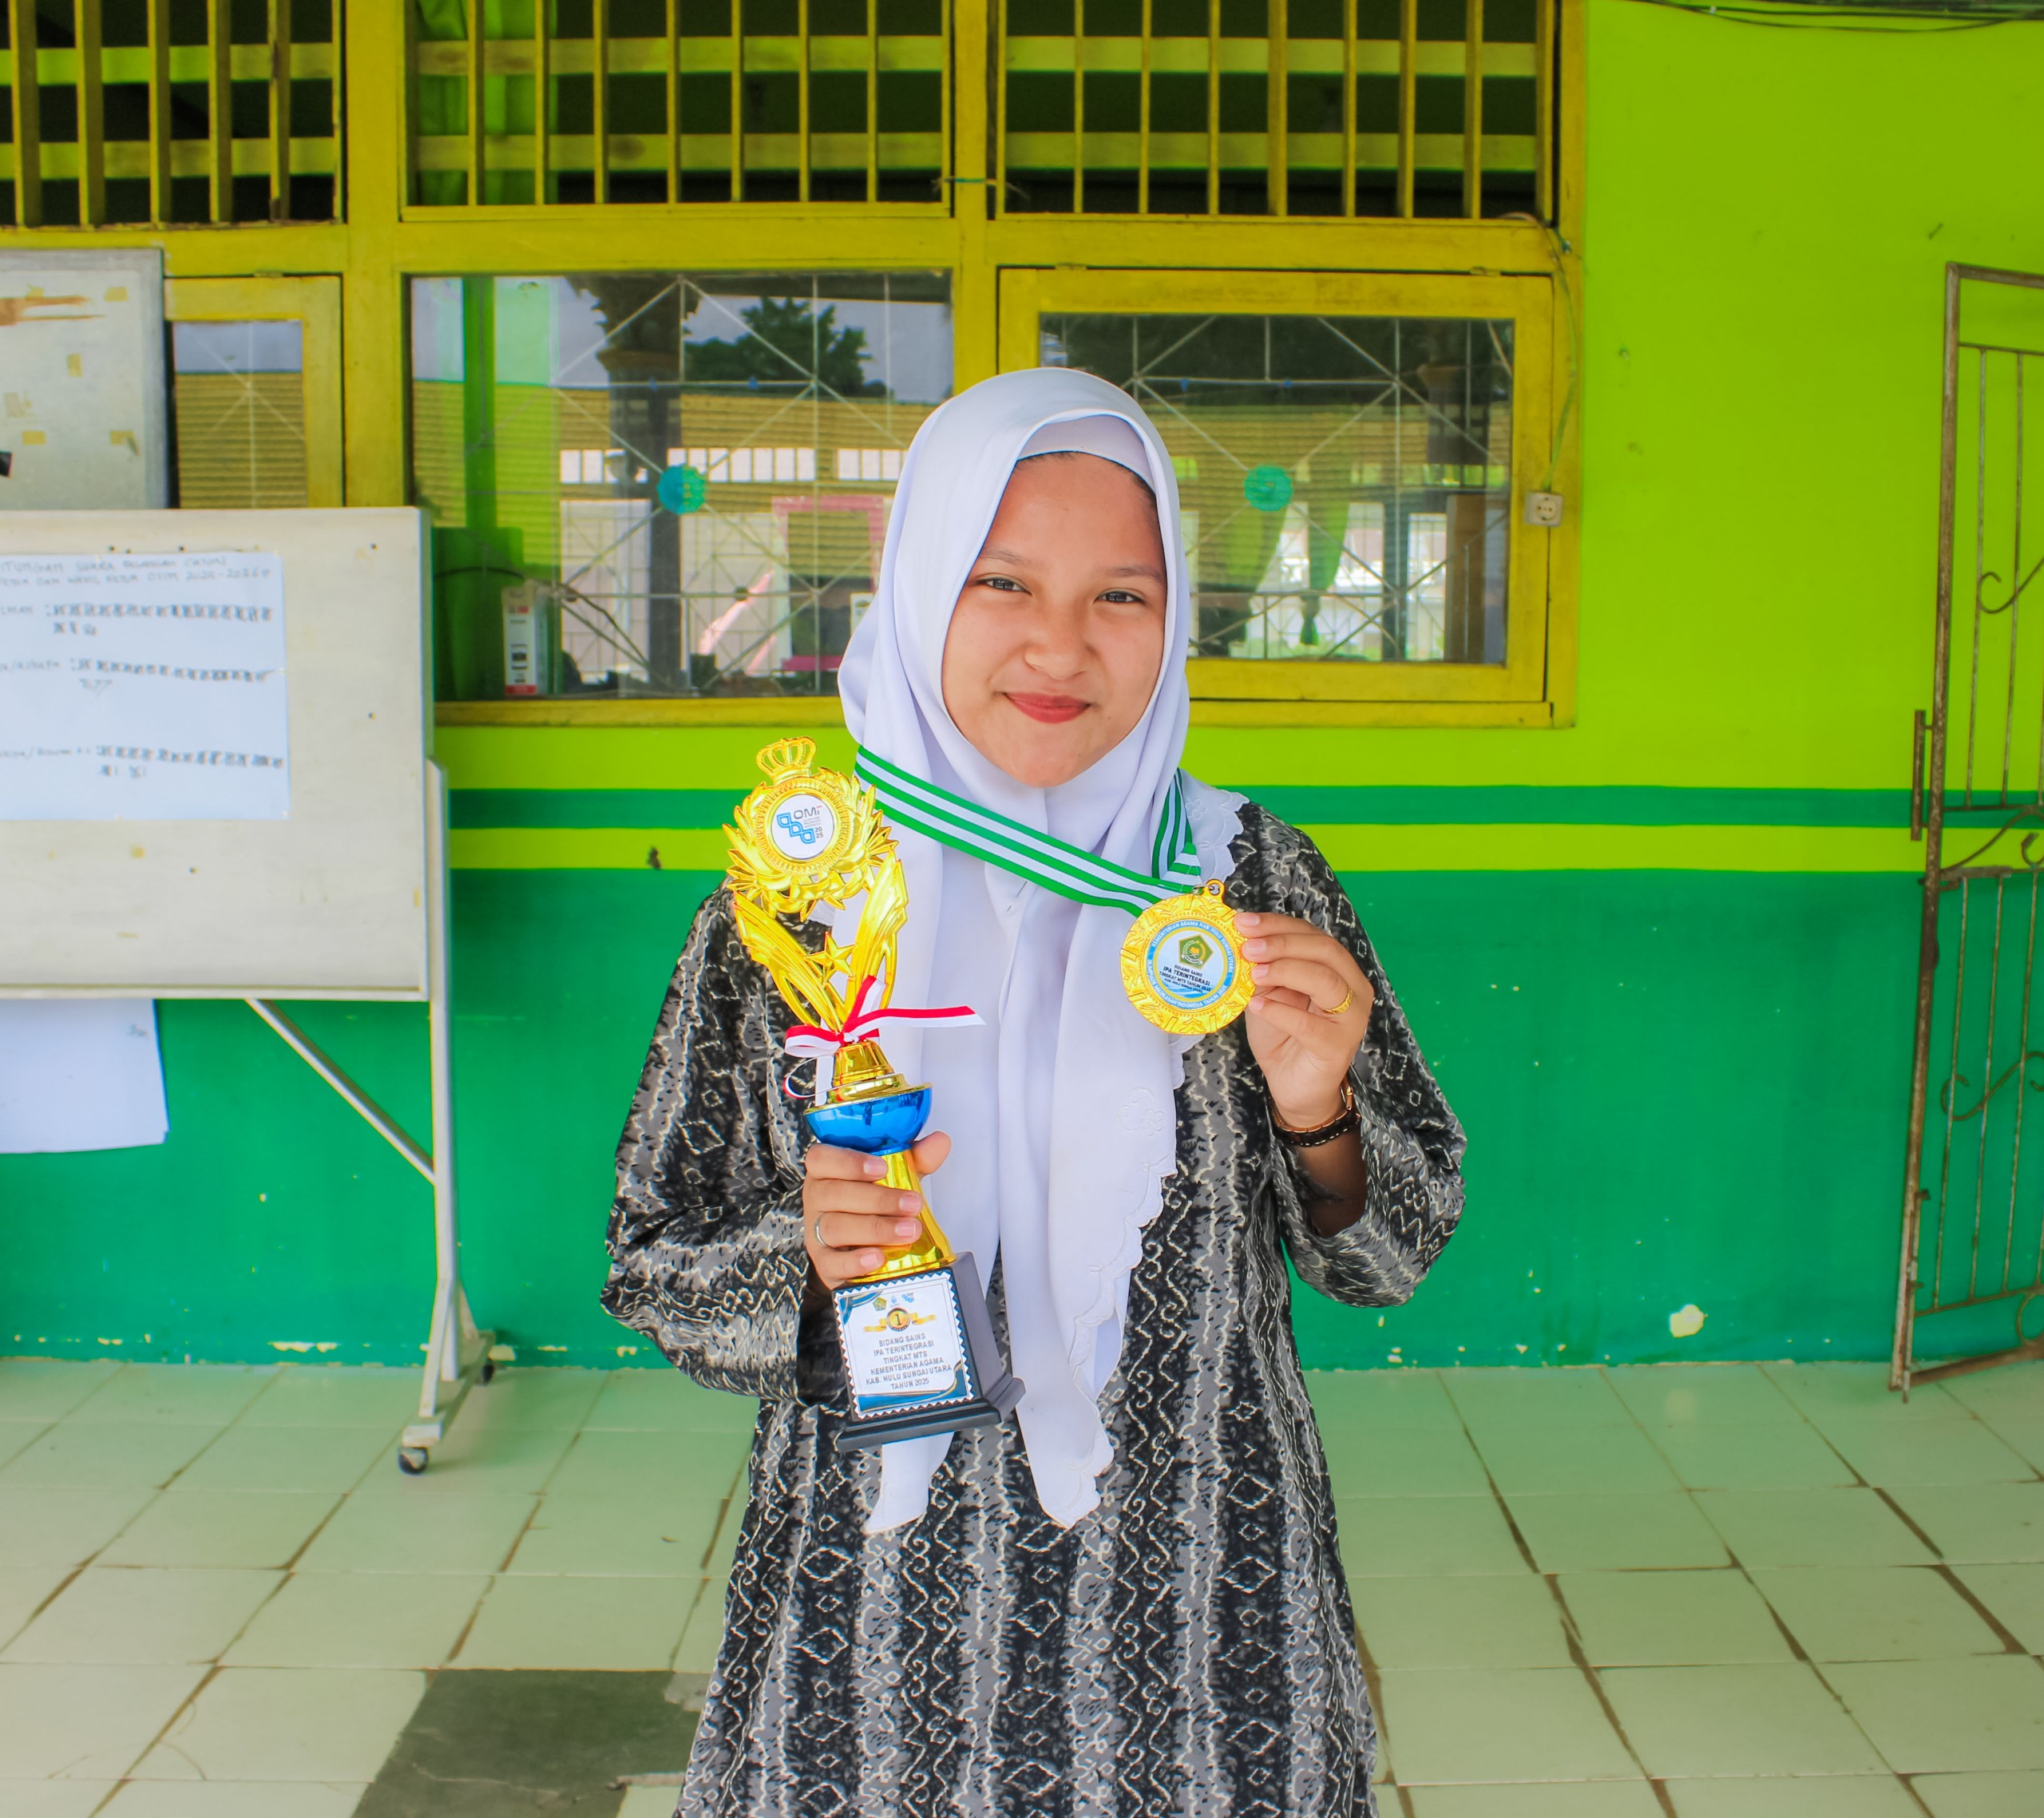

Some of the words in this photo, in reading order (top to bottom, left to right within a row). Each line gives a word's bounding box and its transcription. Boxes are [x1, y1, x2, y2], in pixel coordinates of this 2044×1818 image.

[1152, 923, 1180, 947] KEMENTERIAN
[1211, 928, 1222, 941] HULU
[1221, 938, 1232, 956] SUNGAI
[1147, 959, 1157, 984] OLIMPIADE
[1155, 984, 1177, 1005] MADRASAH
[1203, 994, 1218, 1005] TAHUN
[1159, 971, 1177, 980] TINGKAT
[1174, 969, 1210, 986] TERINTEGRASI
[895, 1314, 901, 1325] 1
[879, 1337, 905, 1347] BIDANG
[905, 1333, 925, 1342] SAINS
[885, 1341, 934, 1354] TERINTEGRASI
[883, 1353, 912, 1364] TINGKAT
[871, 1362, 918, 1375] KEMENTERIAN
[919, 1357, 944, 1367] AGAMA
[883, 1373, 901, 1382] HULU
[902, 1369, 928, 1379] SUNGAI
[929, 1364, 953, 1374] UTARA
[891, 1380, 913, 1390] TAHUN
[914, 1377, 929, 1386] 2025
